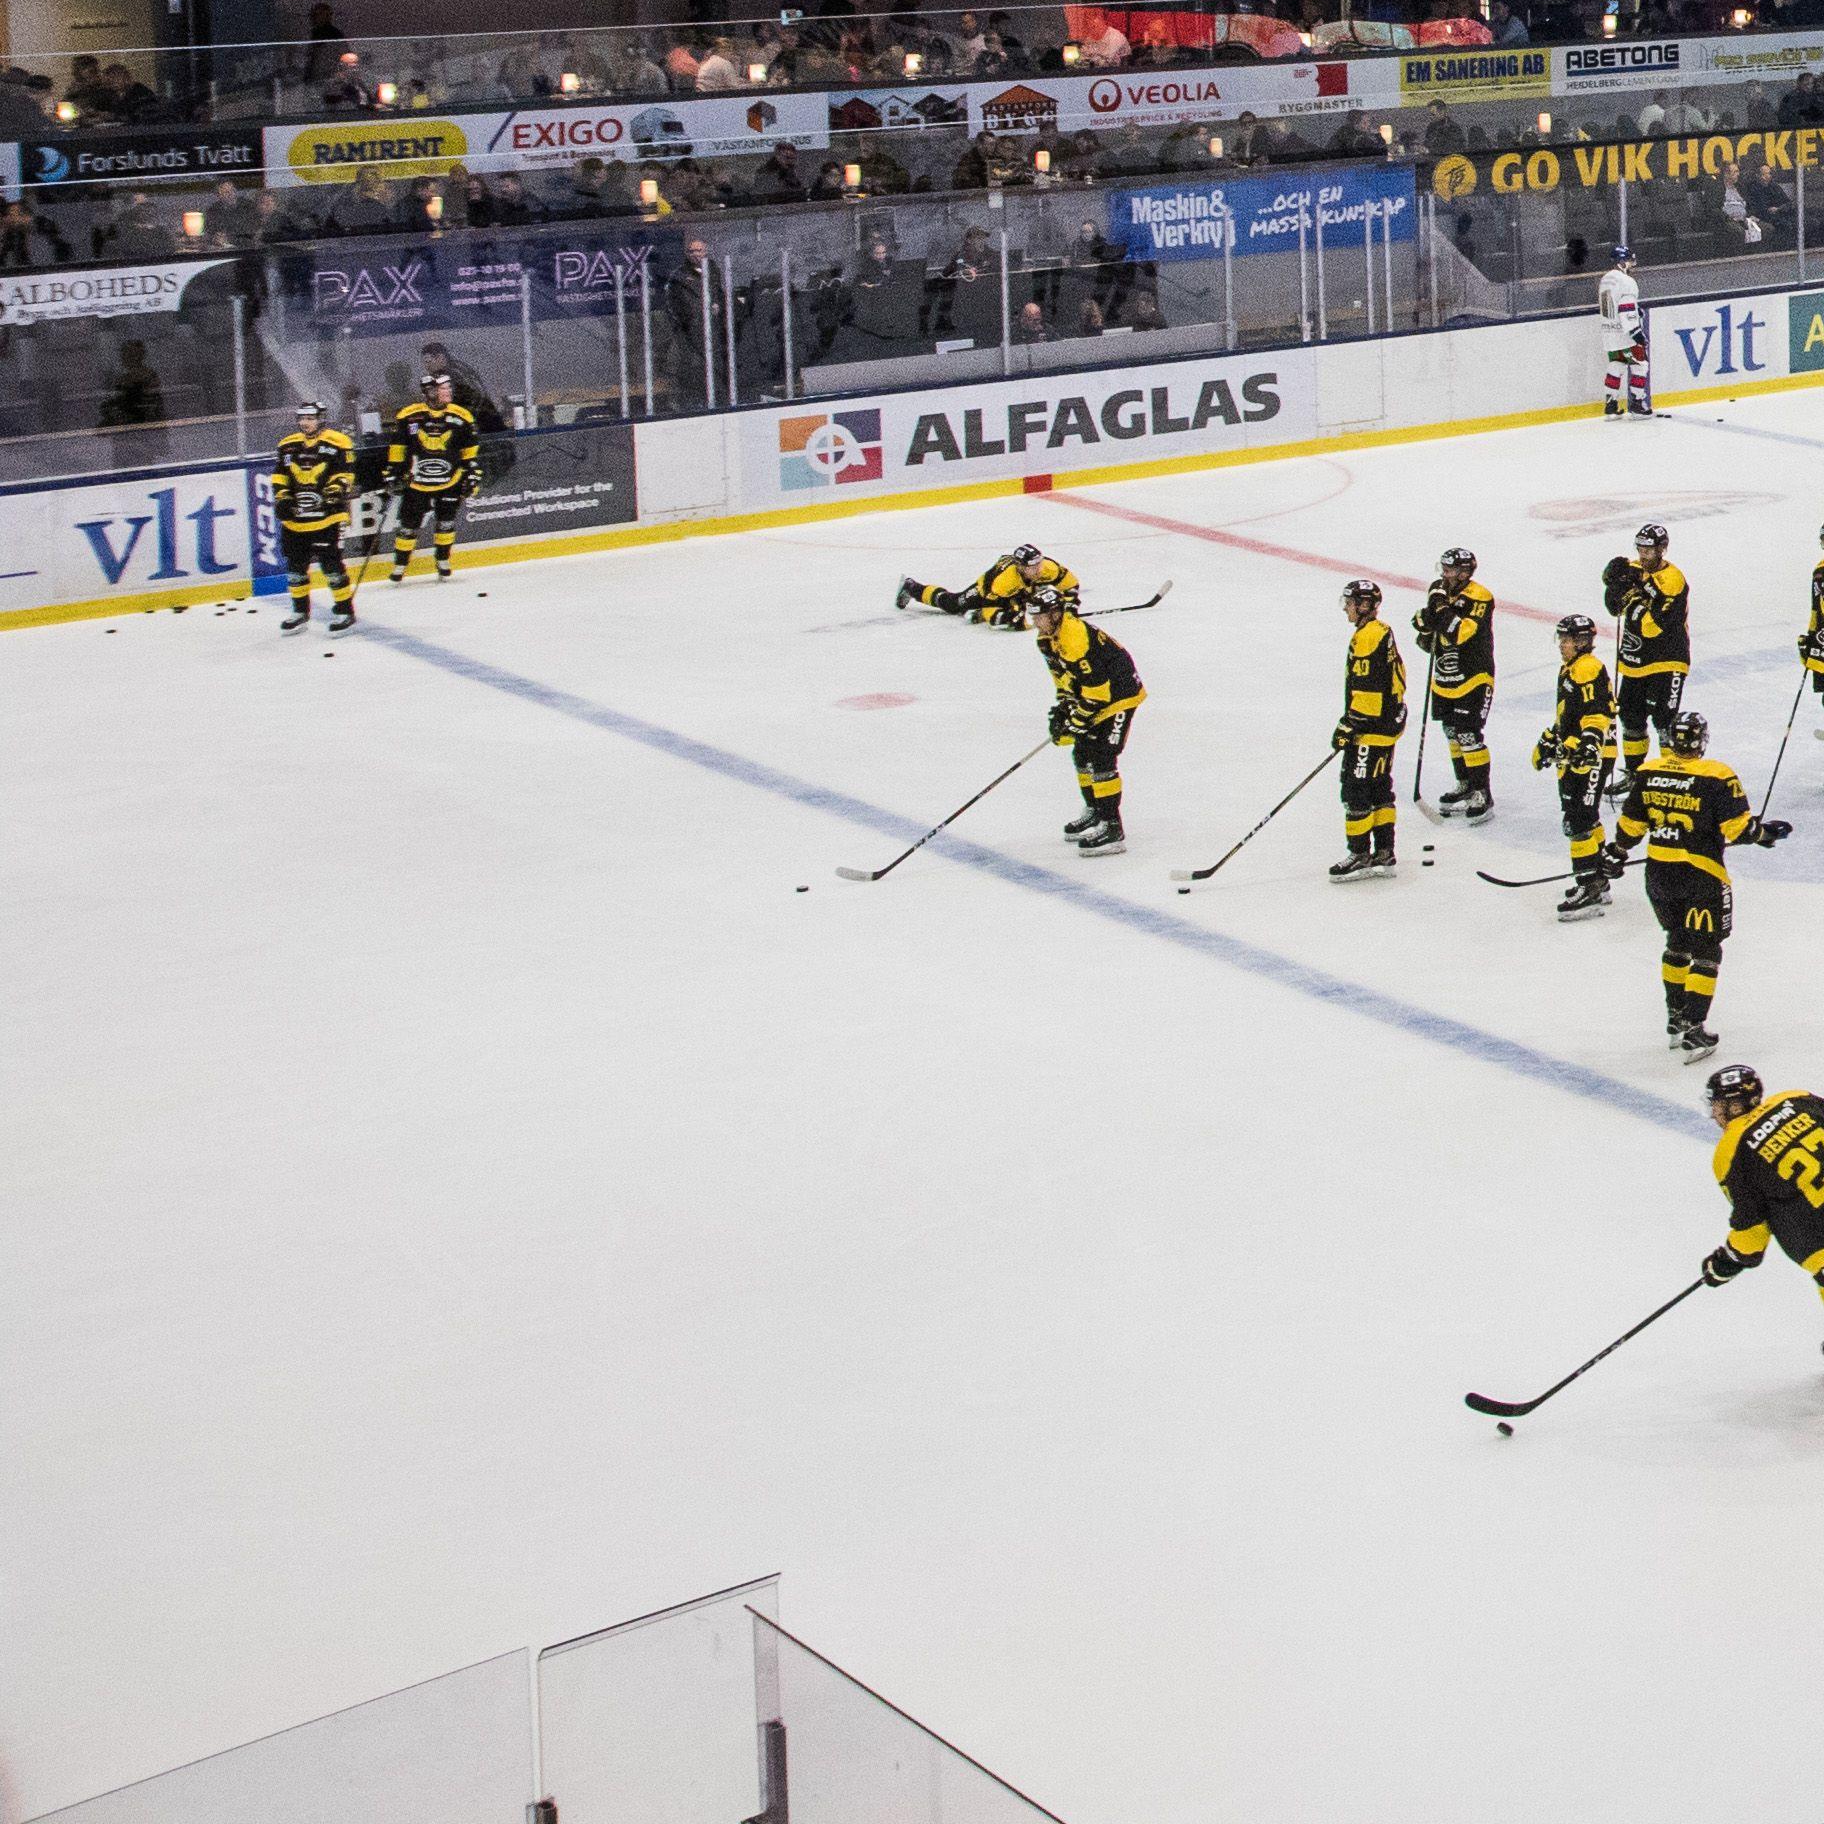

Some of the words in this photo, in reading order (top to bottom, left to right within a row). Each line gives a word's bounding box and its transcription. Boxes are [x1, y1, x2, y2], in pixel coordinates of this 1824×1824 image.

[1406, 59, 1432, 83] EM
[1434, 55, 1520, 81] SANERING
[1521, 52, 1545, 77] AB
[1566, 43, 1681, 71] ABETONG
[1128, 81, 1222, 106] VEOLIA
[313, 137, 445, 165] RAMIRENT
[512, 118, 624, 150] EXIGO
[78, 149, 187, 173] Forslunds
[1492, 150, 1560, 194] GO
[1574, 144, 1652, 188] VIK
[1132, 190, 1227, 224] Maskin&
[1319, 185, 1343, 205] EN
[313, 263, 425, 311] PAX
[556, 244, 655, 291] PAX
[1673, 304, 1766, 377] vlt
[905, 372, 1283, 466] ALFAGLAS
[574, 484, 592, 494] for
[594, 482, 613, 492] the
[75, 485, 237, 585] vlt
[253, 471, 279, 568] CCM
[1747, 1100, 1796, 1150] LOOPIA
[1758, 1112, 1816, 1163] BENKER
